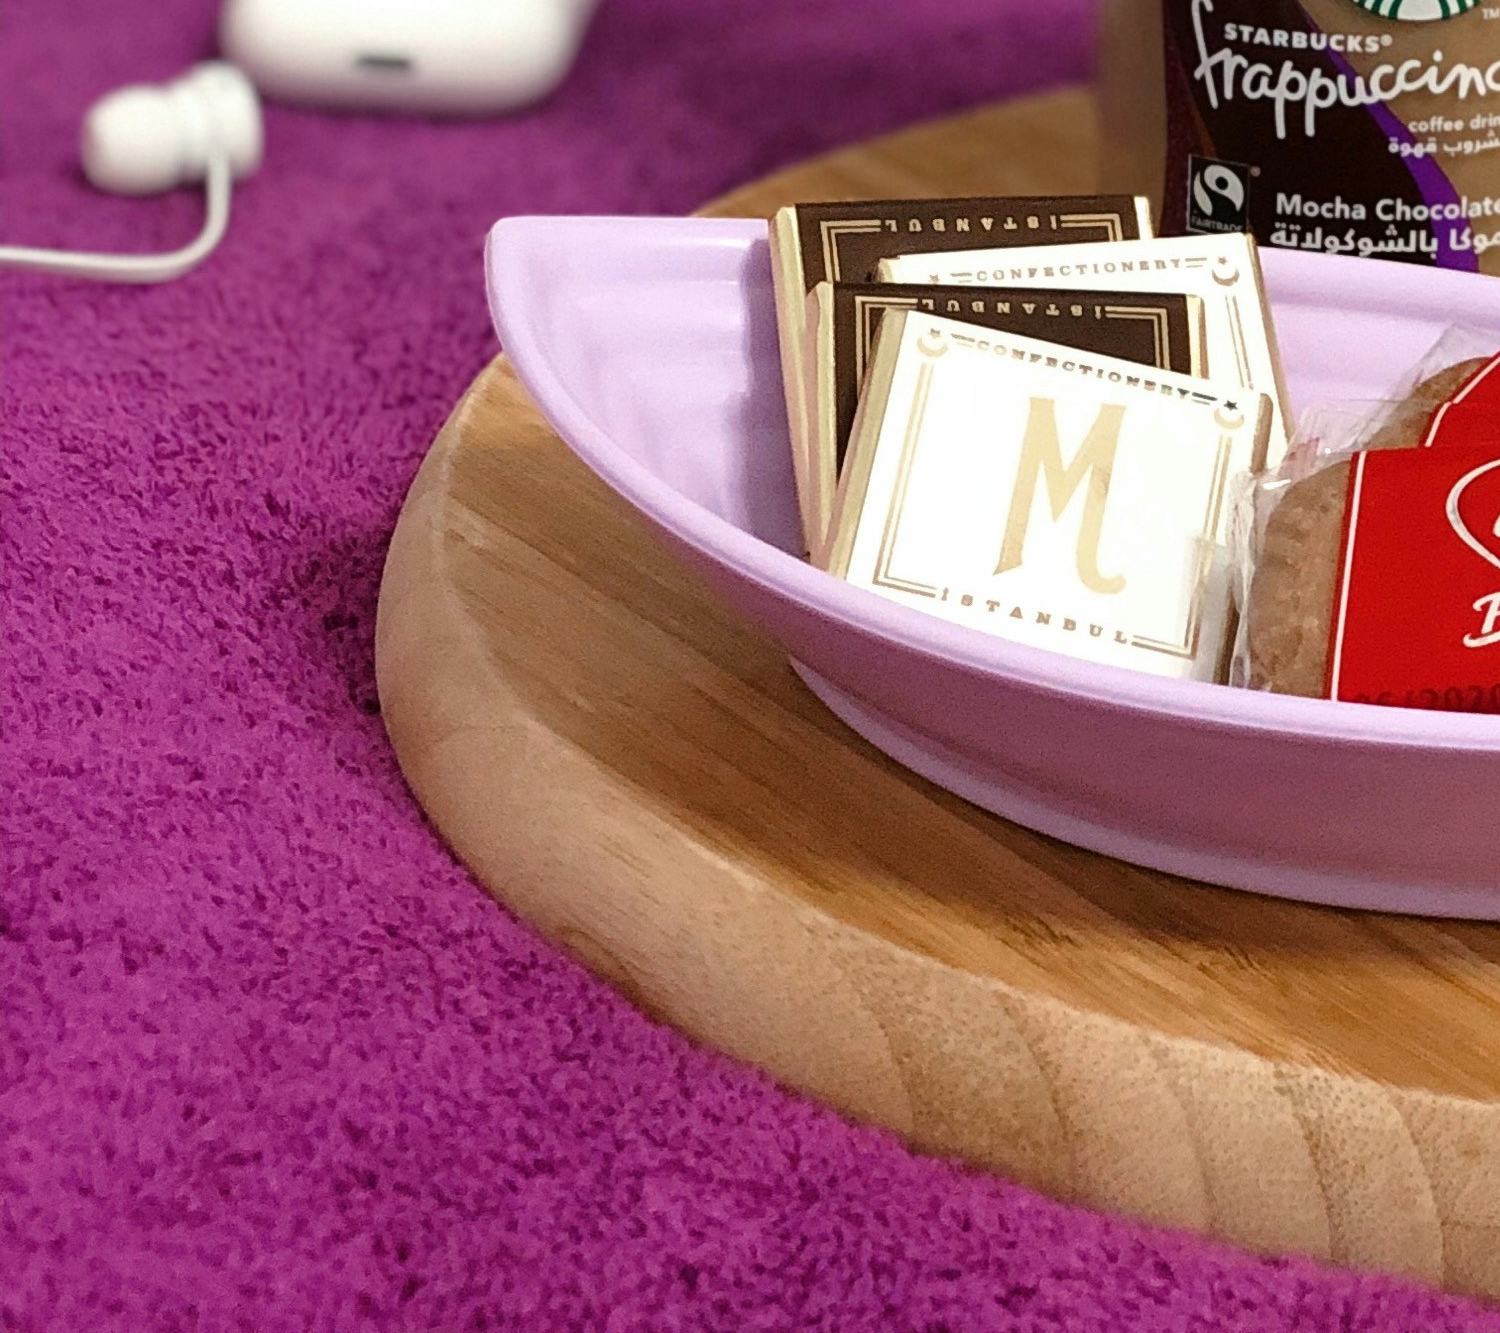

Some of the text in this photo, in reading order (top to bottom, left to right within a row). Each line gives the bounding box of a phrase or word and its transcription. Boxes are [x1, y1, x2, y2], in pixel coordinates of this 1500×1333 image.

[1408, 116, 1464, 133] coffee
[1276, 193, 1366, 221] Mocha
[976, 258, 1181, 282] CONFECTIONERY
[976, 338, 1191, 399] CONFECTIONERY
[993, 396, 1127, 595] M
